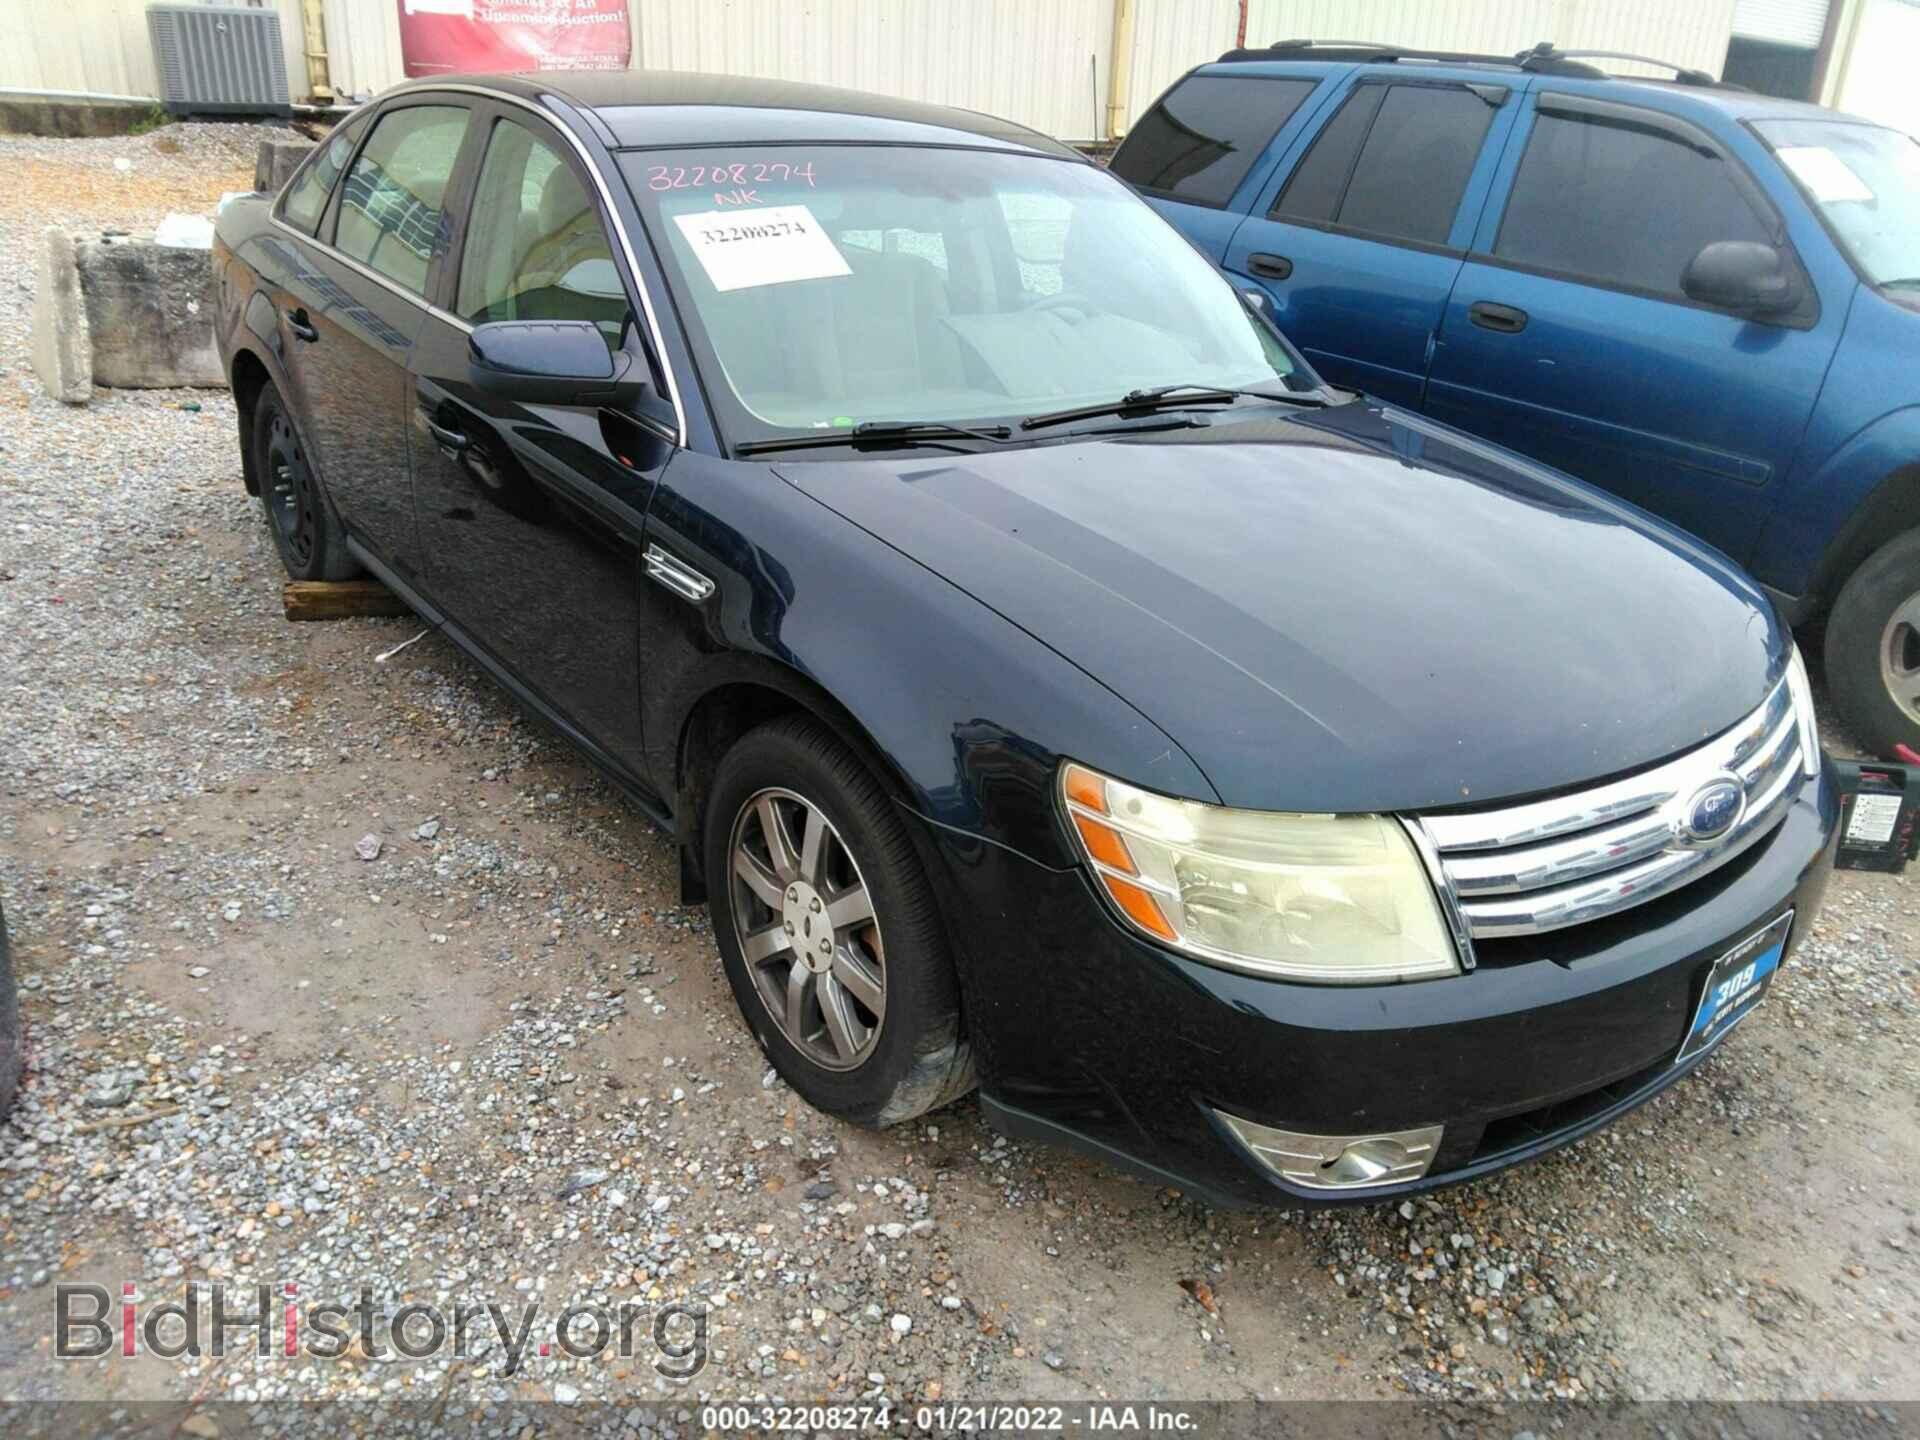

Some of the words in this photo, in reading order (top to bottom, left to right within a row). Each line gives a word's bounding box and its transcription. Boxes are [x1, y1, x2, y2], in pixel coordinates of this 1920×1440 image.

[483, 9, 558, 25] Upcoming
[559, 10, 625, 25] Auction!
[648, 161, 816, 191] 32208274
[700, 222, 807, 245] 32208274
[1715, 961, 1757, 1008] 309
